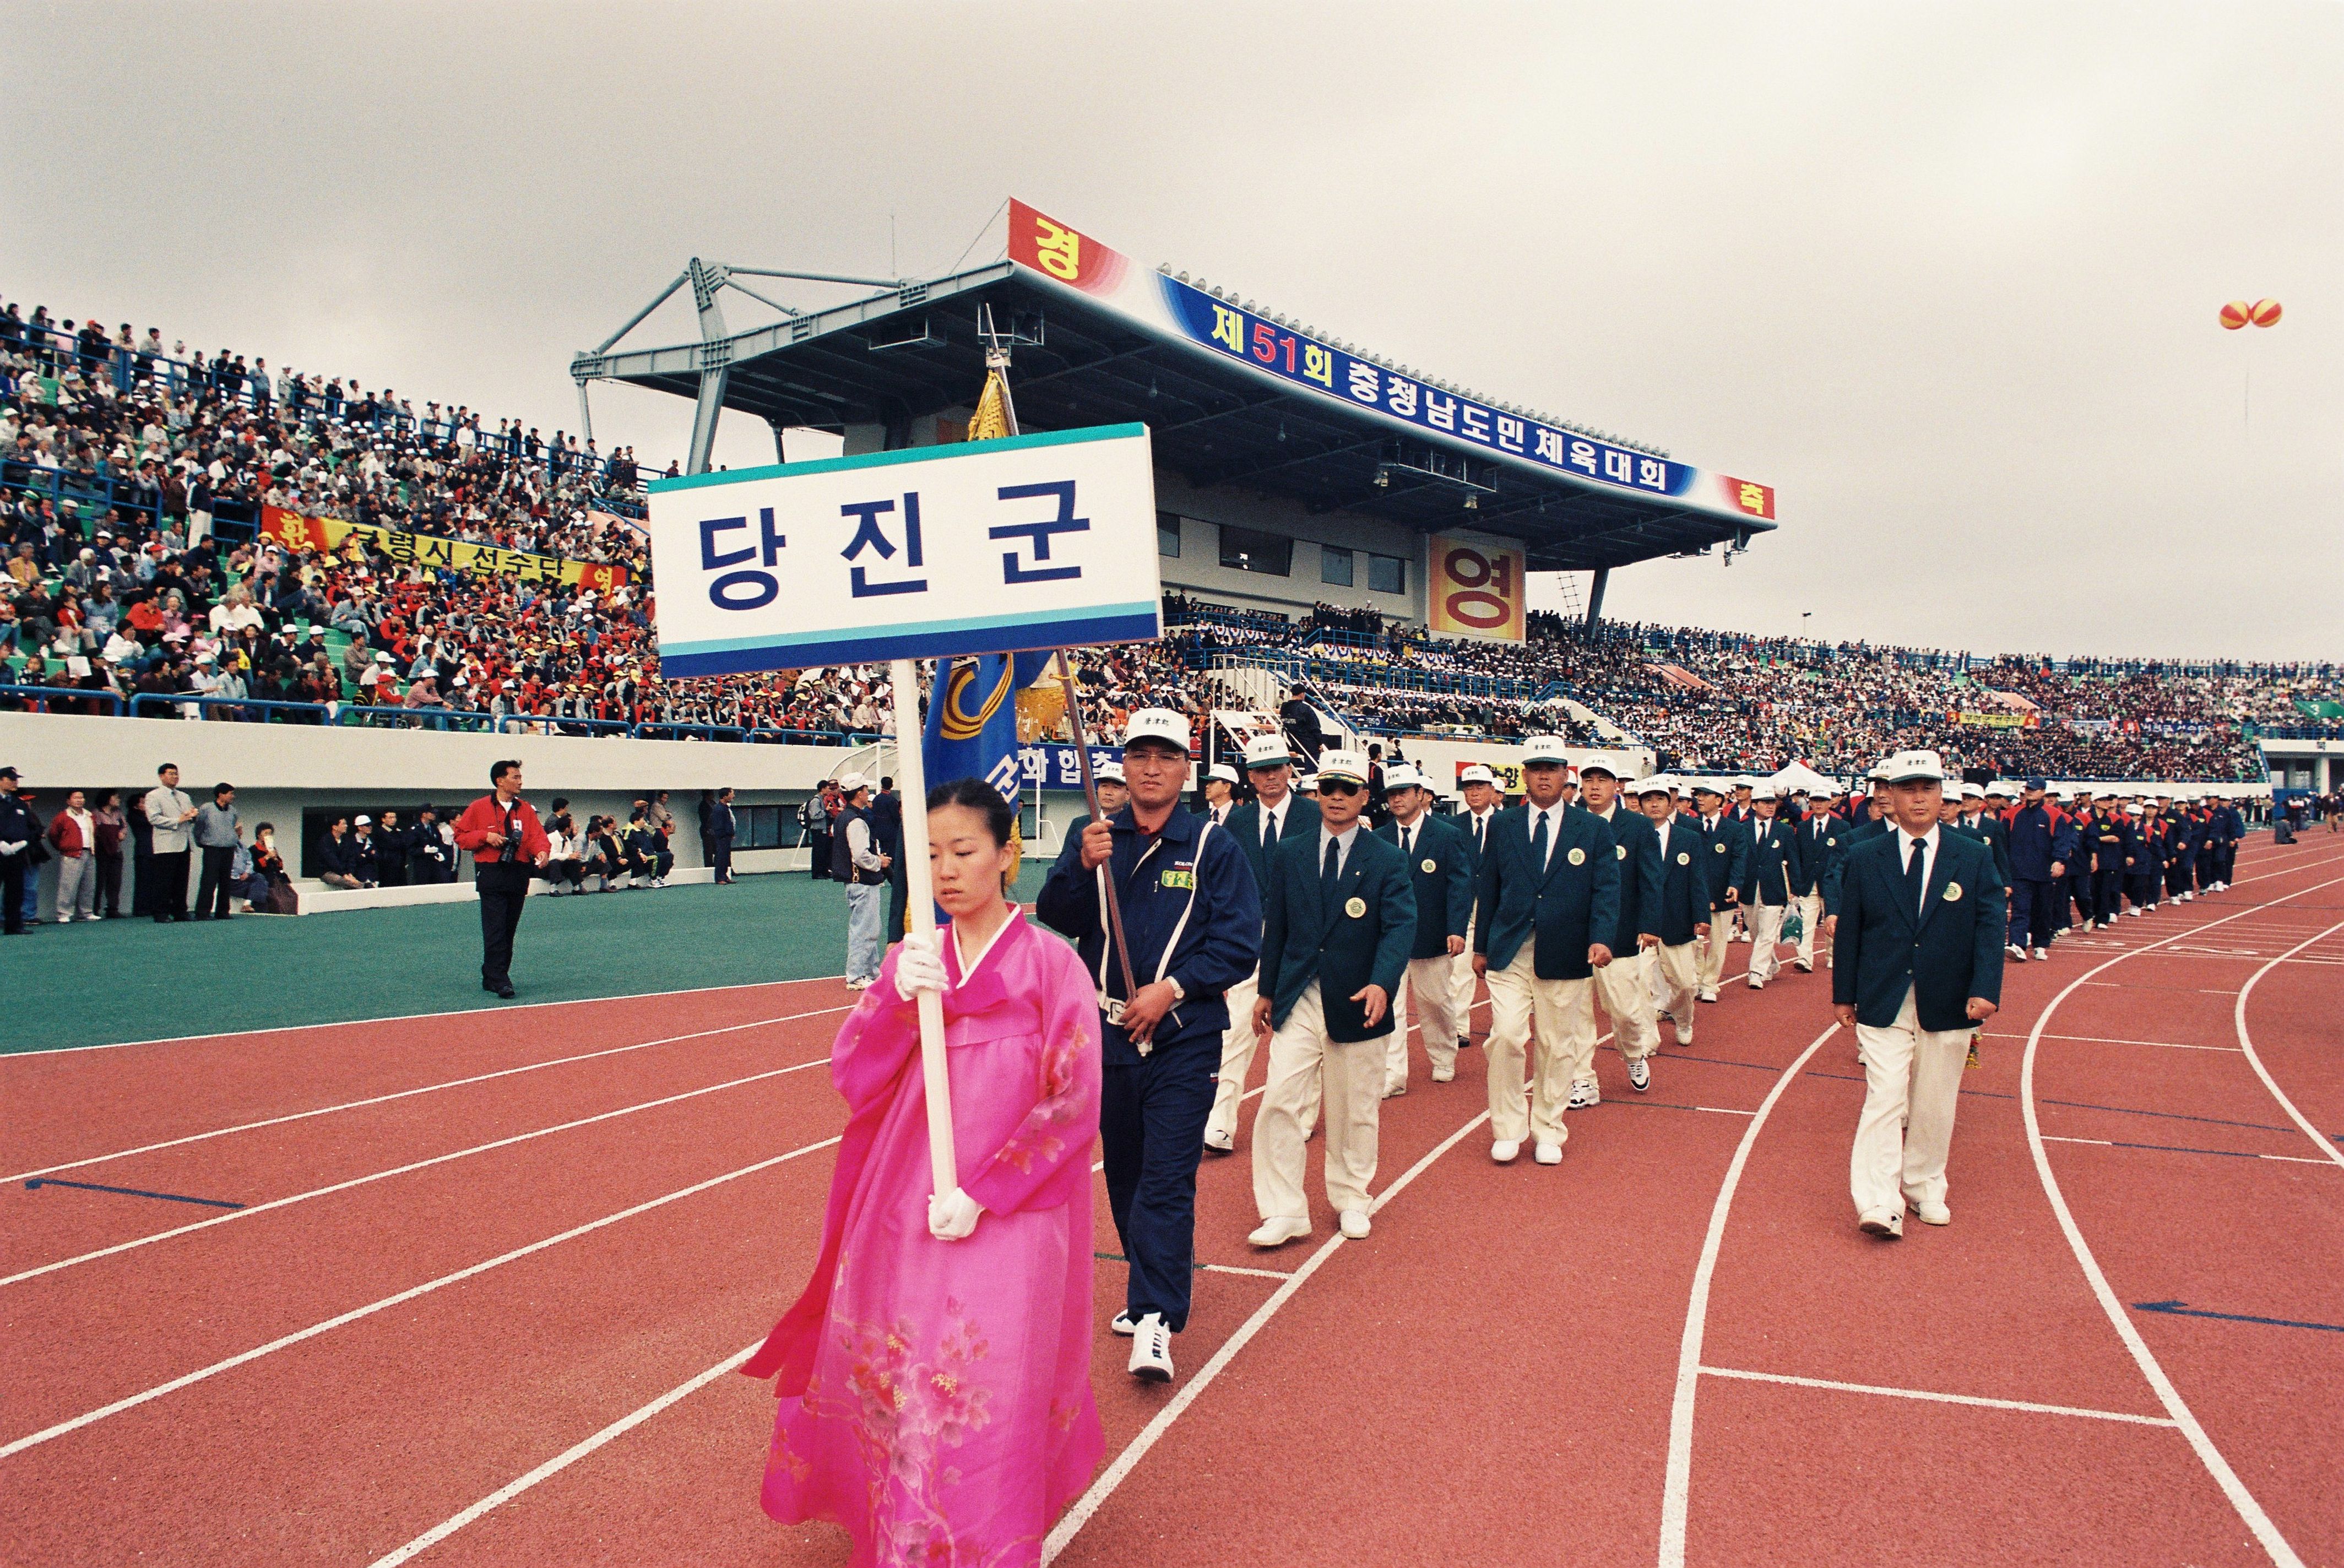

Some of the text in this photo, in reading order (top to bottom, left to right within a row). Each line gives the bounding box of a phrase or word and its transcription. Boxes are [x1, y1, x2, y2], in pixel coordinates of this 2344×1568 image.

[1035, 216, 1079, 280] 경
[1211, 304, 1333, 388] 제51회
[1739, 482, 1764, 514] 축
[698, 479, 1090, 611] 당진군
[1444, 547, 1511, 629] 영
[2310, 704, 2320, 715] 3
